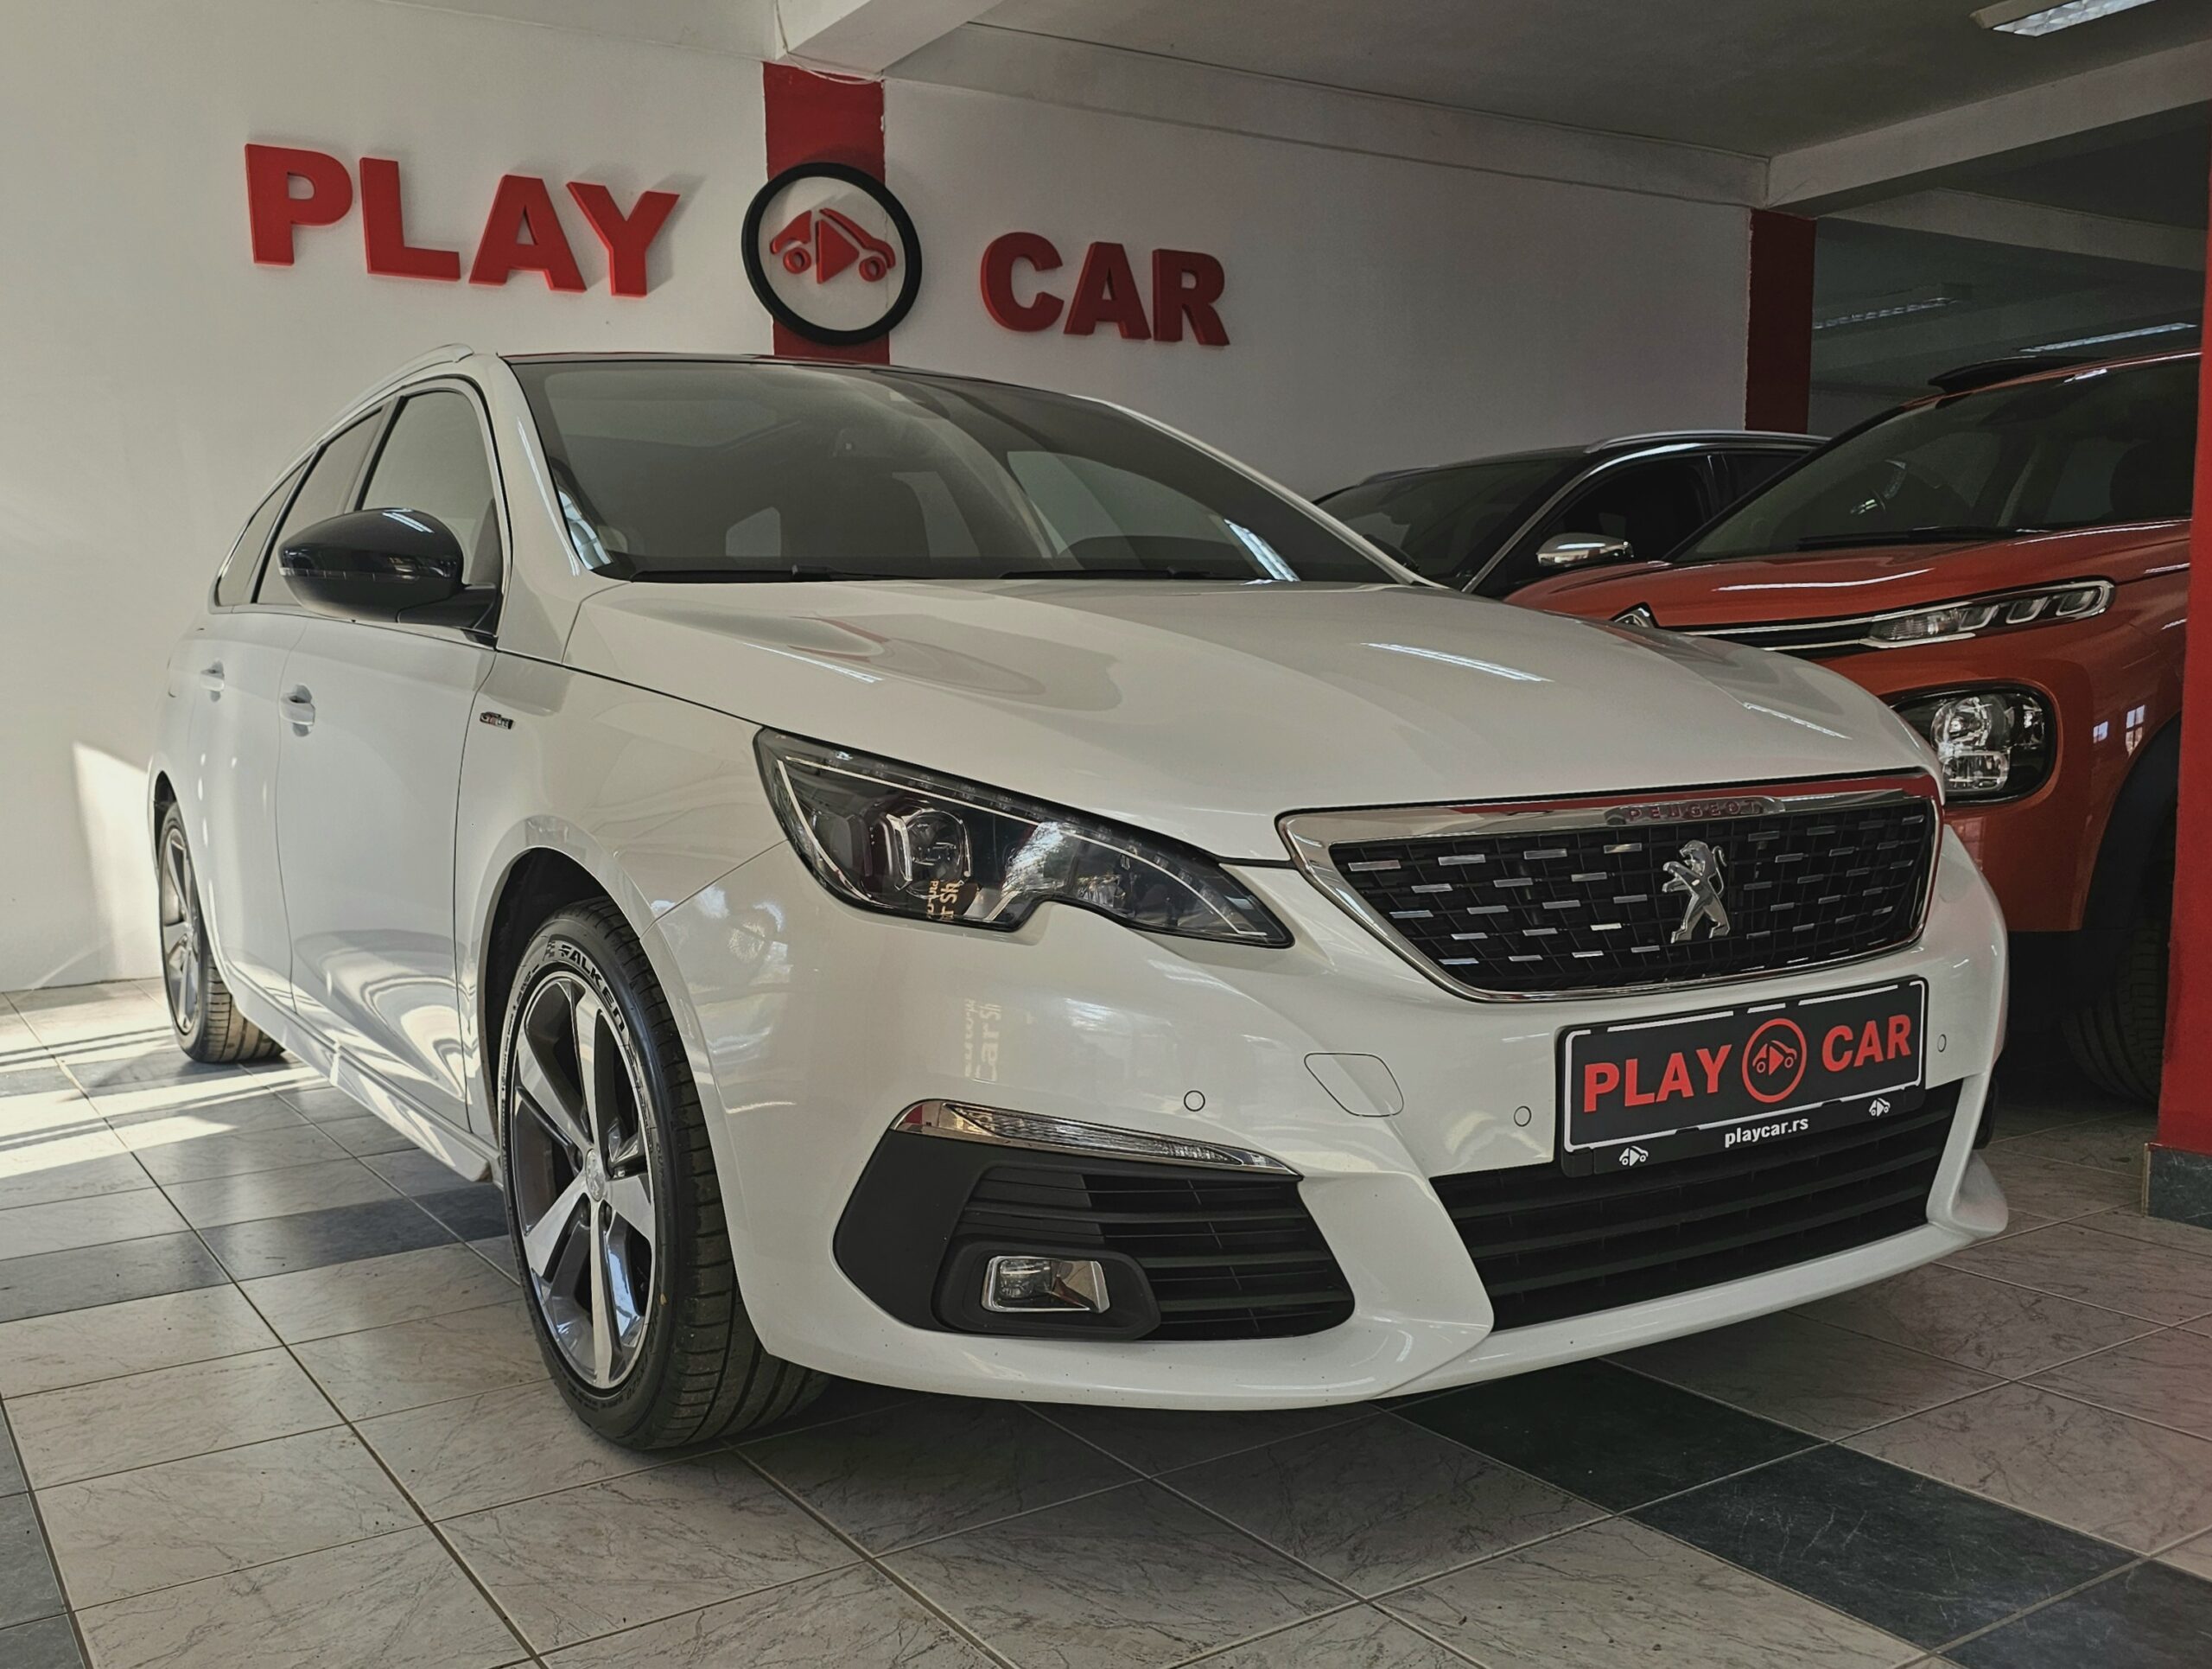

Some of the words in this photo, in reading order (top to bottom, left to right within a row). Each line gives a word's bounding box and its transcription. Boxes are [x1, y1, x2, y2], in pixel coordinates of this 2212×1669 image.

[245, 143, 681, 297] PLAY
[980, 231, 1230, 347] CAR
[1629, 798, 1764, 821] PEUGEOT
[557, 944, 626, 1033] FALKEN
[1583, 1043, 1732, 1113] PLAY
[1821, 1013, 1912, 1073] CAR
[1725, 1118, 1809, 1149] playcar.rs
